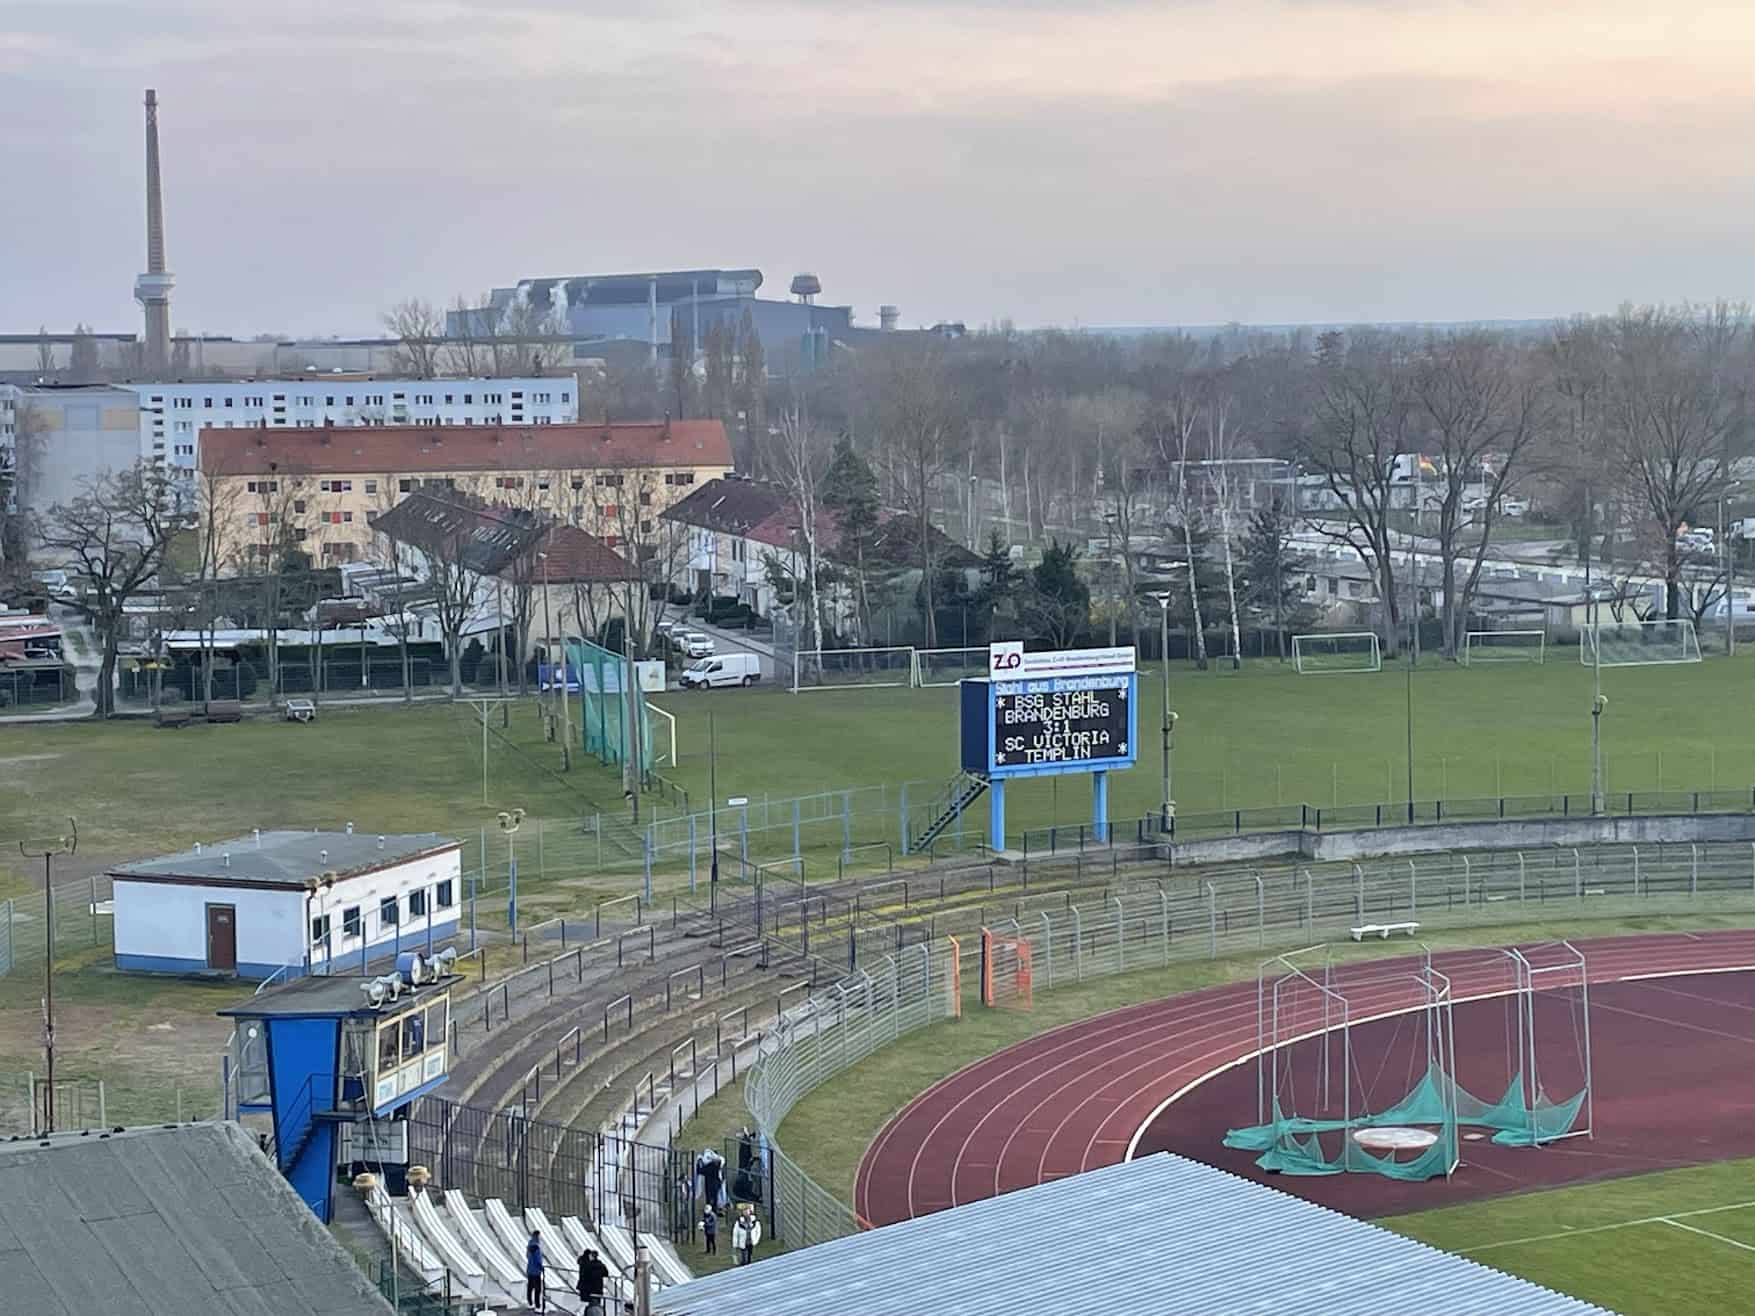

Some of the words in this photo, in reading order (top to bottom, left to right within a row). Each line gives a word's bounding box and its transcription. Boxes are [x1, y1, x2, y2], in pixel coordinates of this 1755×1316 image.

[1027, 681, 1049, 693] aus
[1054, 676, 1128, 691] Brandenburg
[1014, 694, 1044, 709] BSG
[1052, 691, 1100, 706] STAHL
[1004, 703, 1110, 724] BRANDENBURG
[1043, 719, 1070, 734] 3:1
[1004, 736, 1025, 751] SC
[1033, 730, 1110, 748] VICTORIA
[1024, 745, 1091, 763] TEMPLIN
